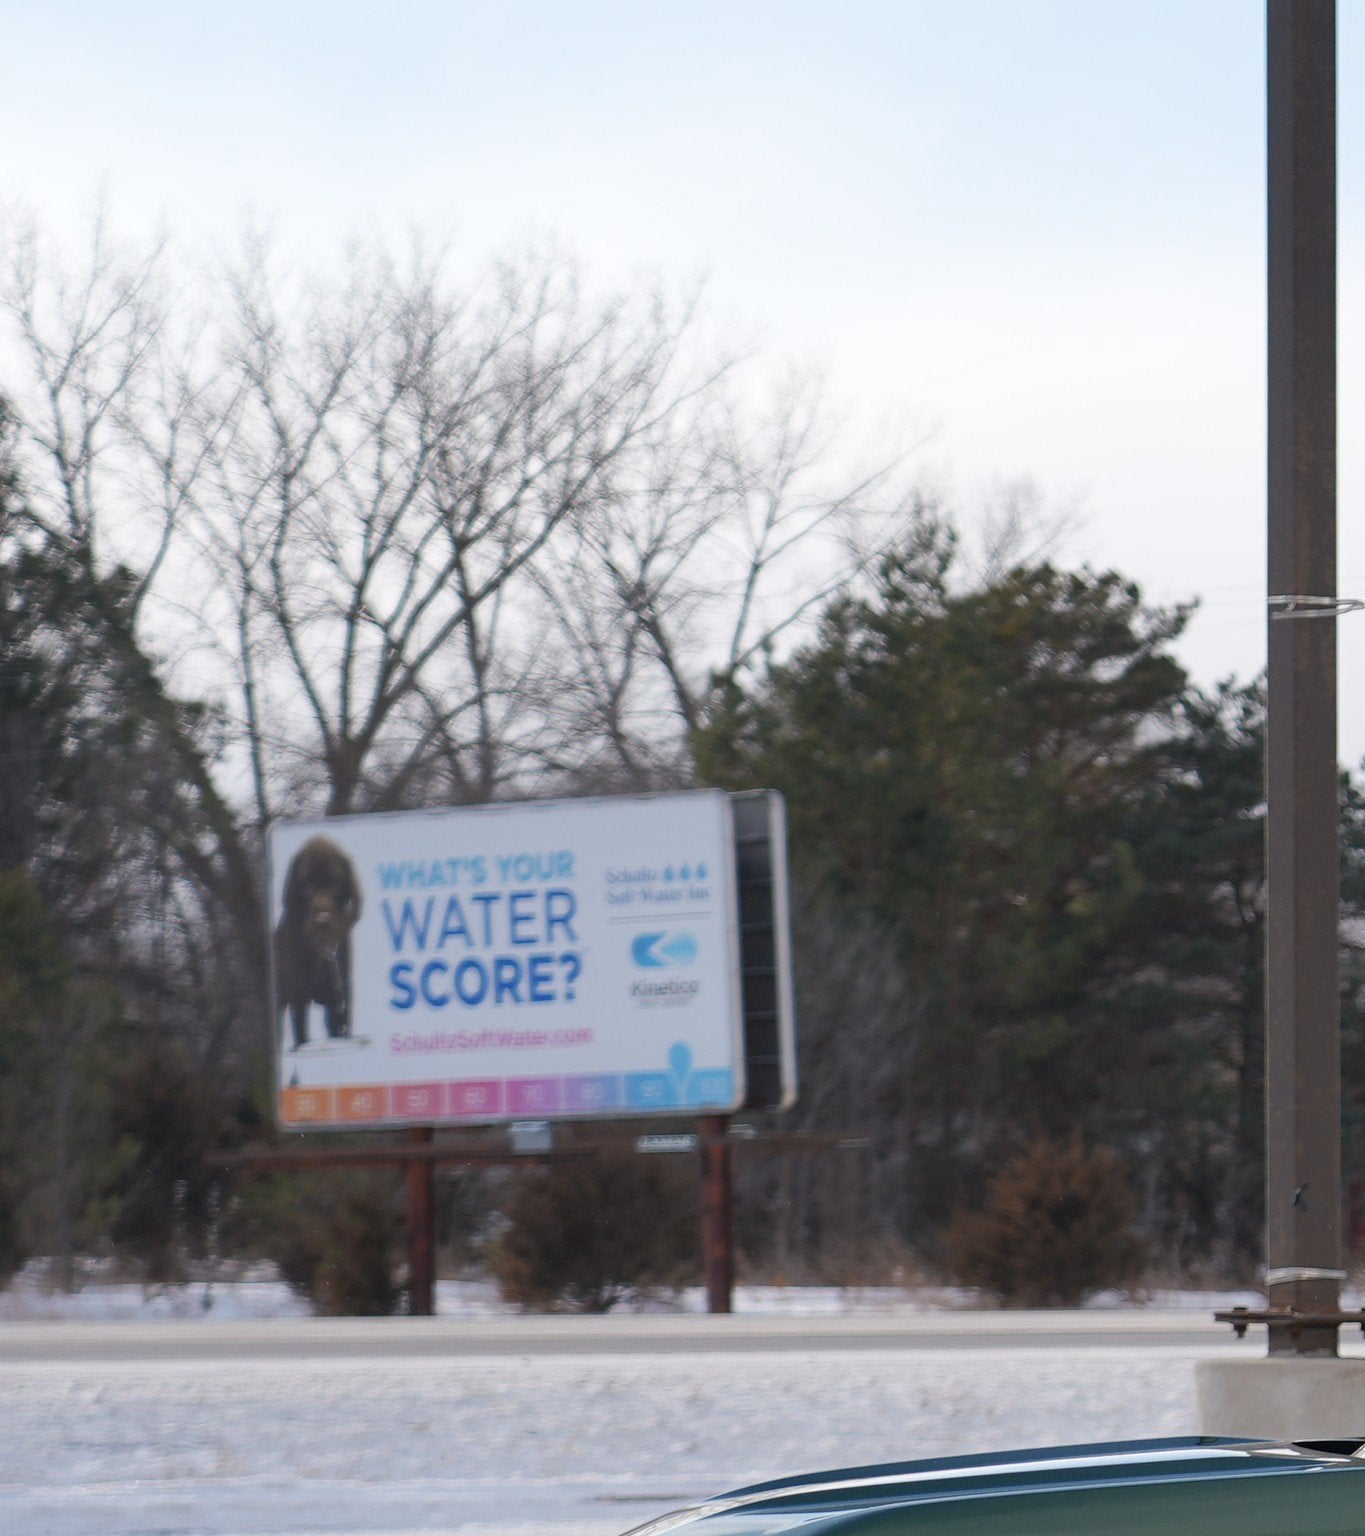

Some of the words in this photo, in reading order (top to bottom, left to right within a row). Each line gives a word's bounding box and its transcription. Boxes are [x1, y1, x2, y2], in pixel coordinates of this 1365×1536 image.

[378, 854, 488, 890] WHAT'S
[498, 849, 576, 882] YOUR
[382, 890, 580, 953] WATER
[388, 952, 583, 1010] SCORE?
